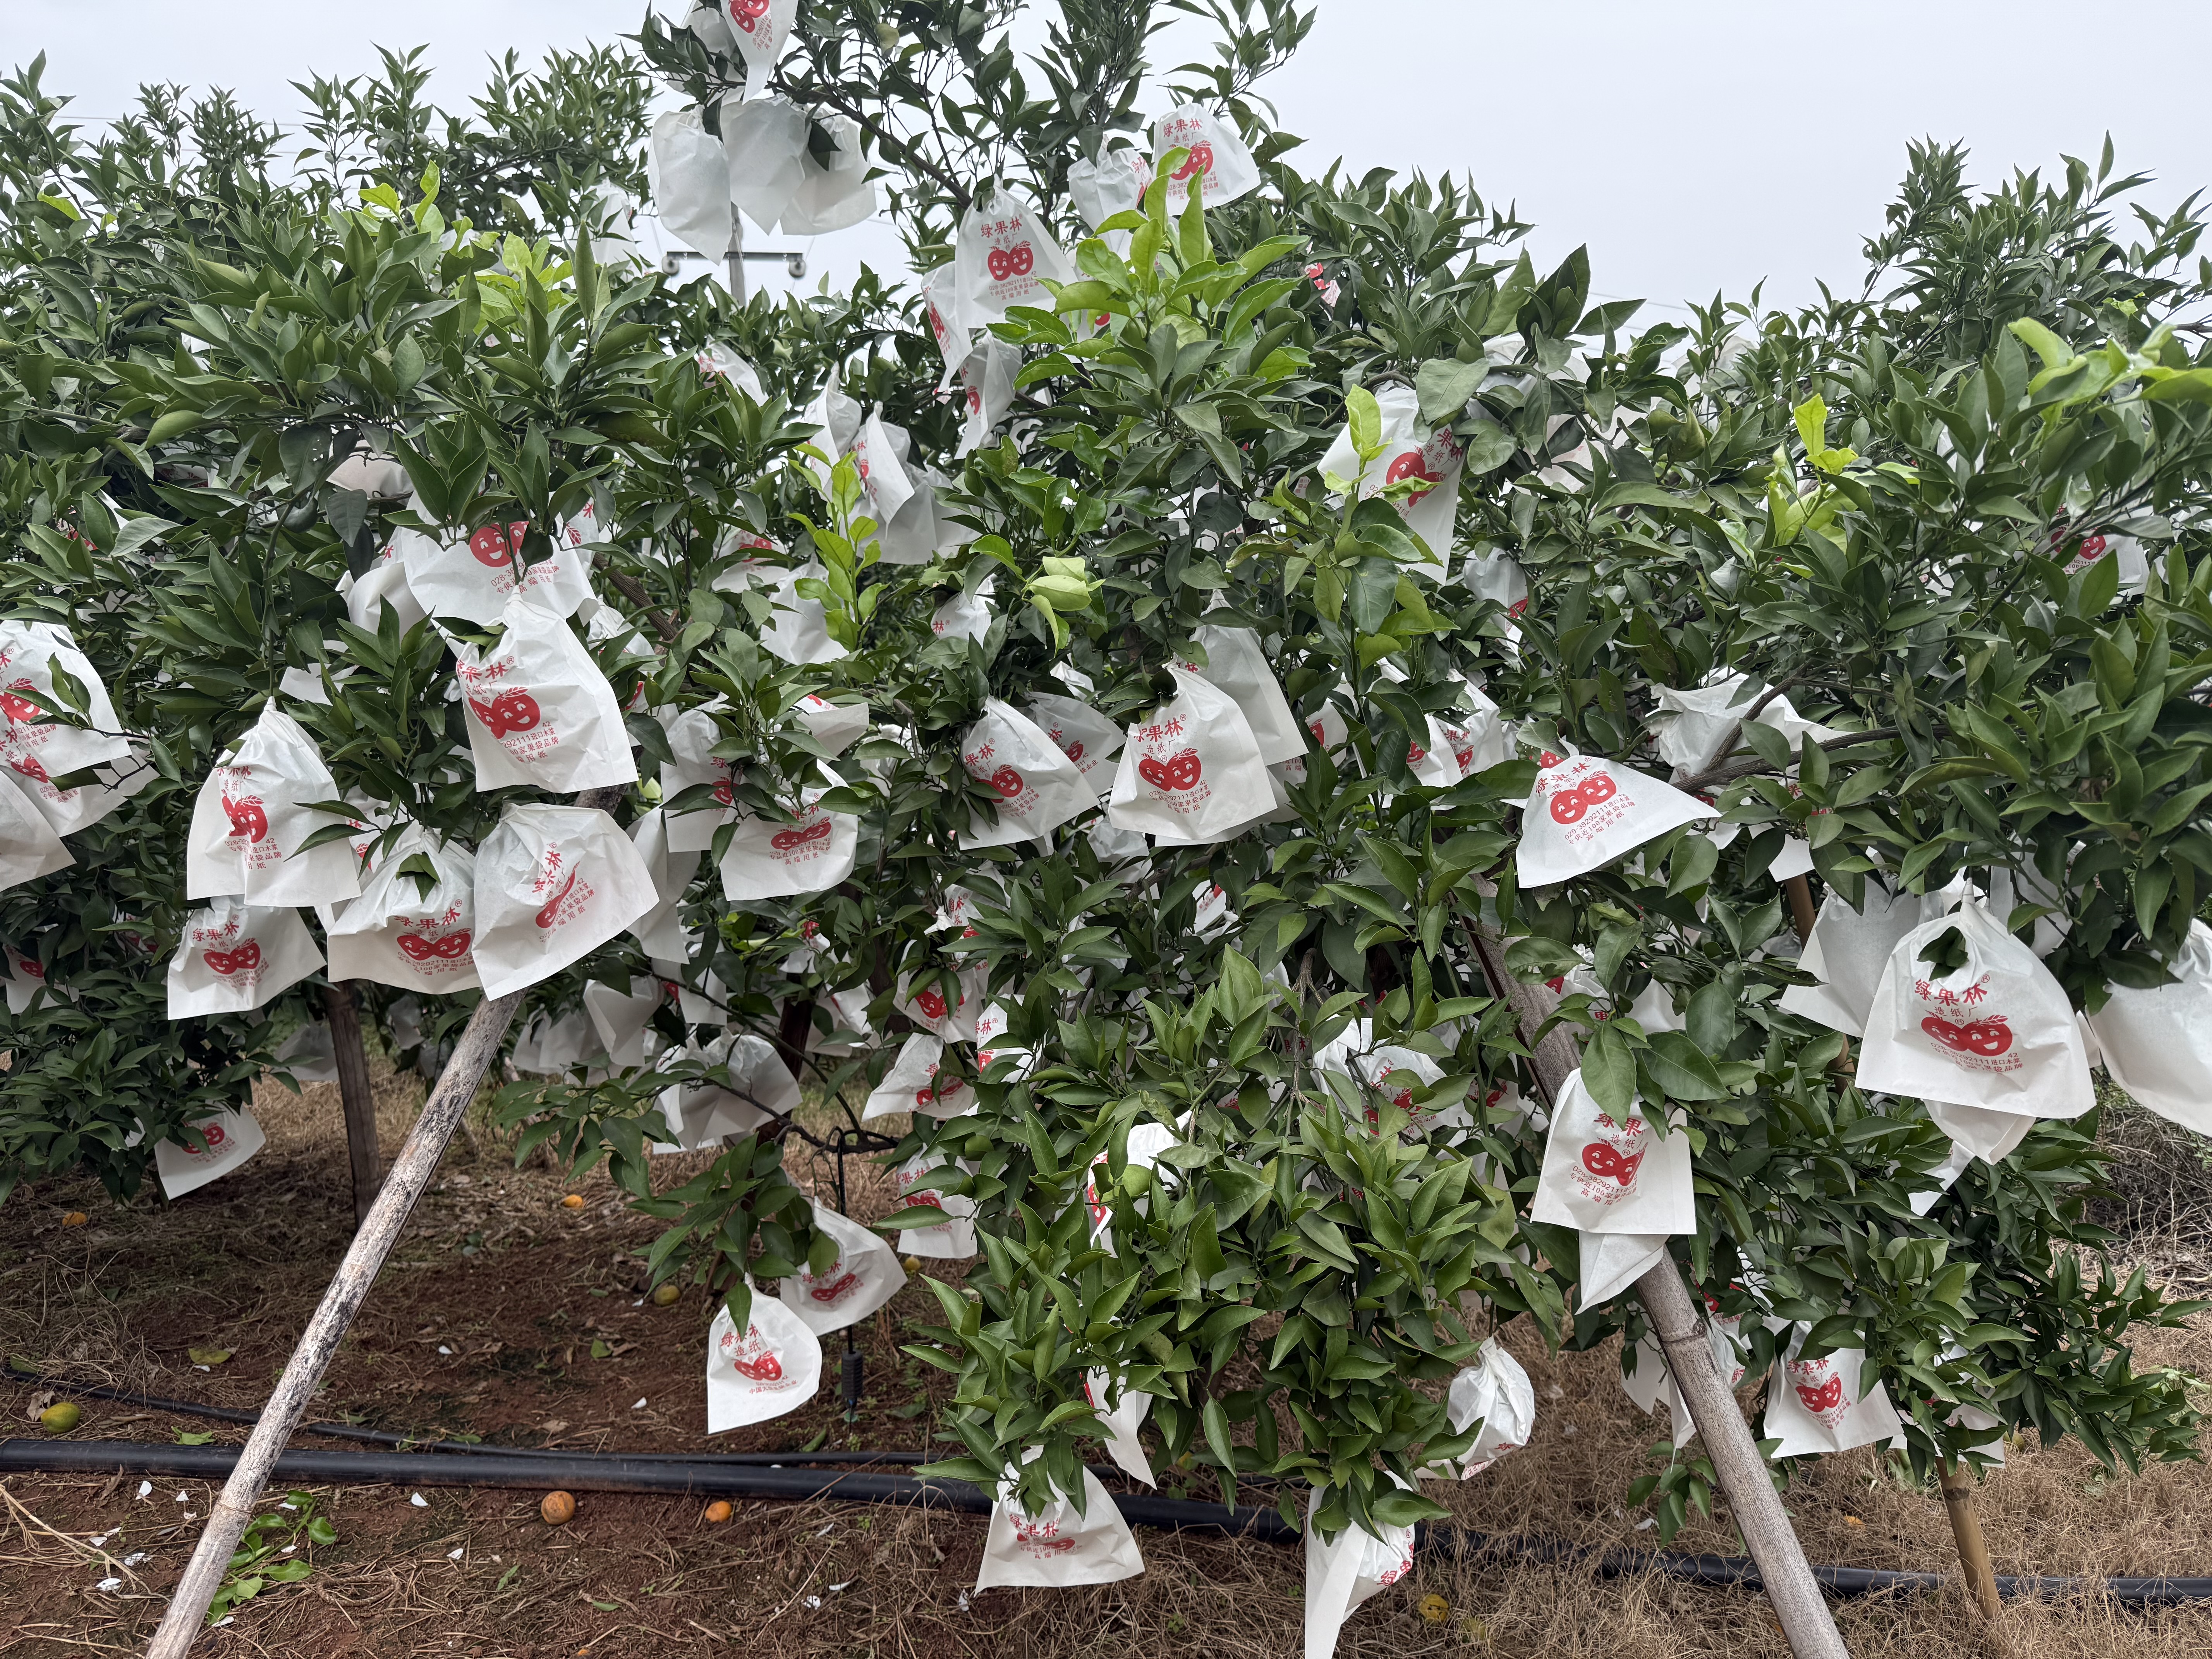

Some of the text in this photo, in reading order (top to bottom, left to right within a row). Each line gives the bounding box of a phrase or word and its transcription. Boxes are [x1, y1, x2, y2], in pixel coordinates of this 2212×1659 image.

[1163, 118, 1202, 138] 绿果林
[1174, 132, 1196, 143] 造纸厂
[981, 216, 1023, 238] 绿果林
[994, 232, 1017, 246] 造纸厂
[989, 276, 1037, 290] 028-38292111进口
[1424, 442, 1453, 466] 造纸厂
[965, 743, 995, 767] 果林
[1147, 739, 1175, 754] 造纸厂
[785, 852, 819, 865] 高端用纸
[394, 907, 461, 927] 绿果林
[193, 921, 239, 941] 绿果林
[414, 926, 451, 936] 造纸厂
[1915, 979, 1988, 1006] 绿果林
[1934, 1006, 1978, 1017] 造纸厂
[1610, 1134, 1644, 1149] 造纸厂
[1787, 1357, 1829, 1376] 绿果林
[1009, 1514, 1059, 1537] 绿果林
